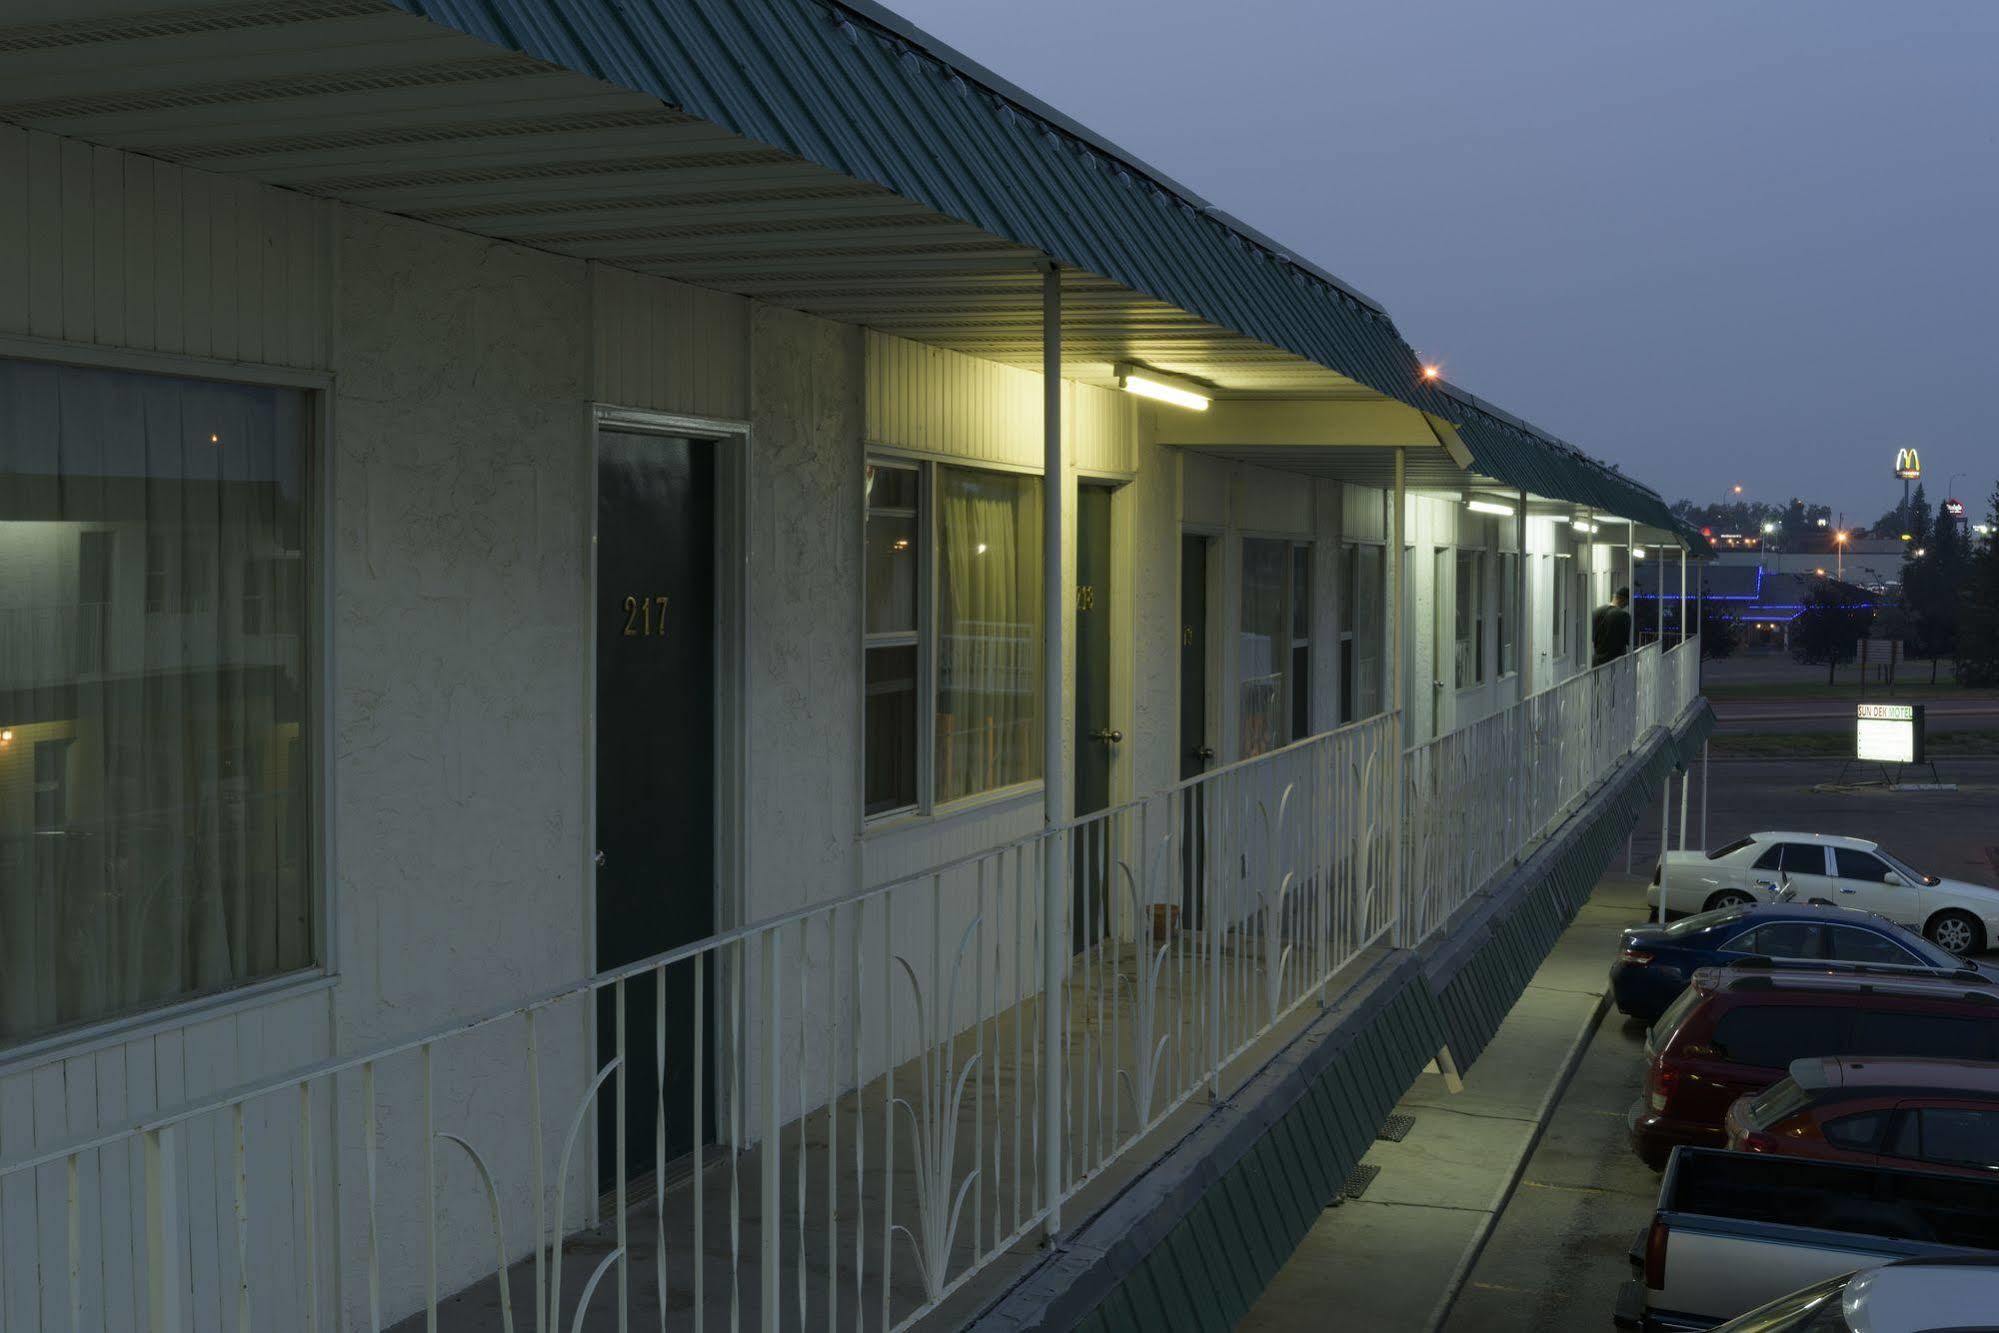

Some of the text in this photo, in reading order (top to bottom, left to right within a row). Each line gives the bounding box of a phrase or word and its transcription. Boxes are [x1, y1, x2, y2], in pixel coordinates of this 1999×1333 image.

[623, 596, 669, 636] 217
[1858, 706, 1913, 718] SUN DEK MOTEL
